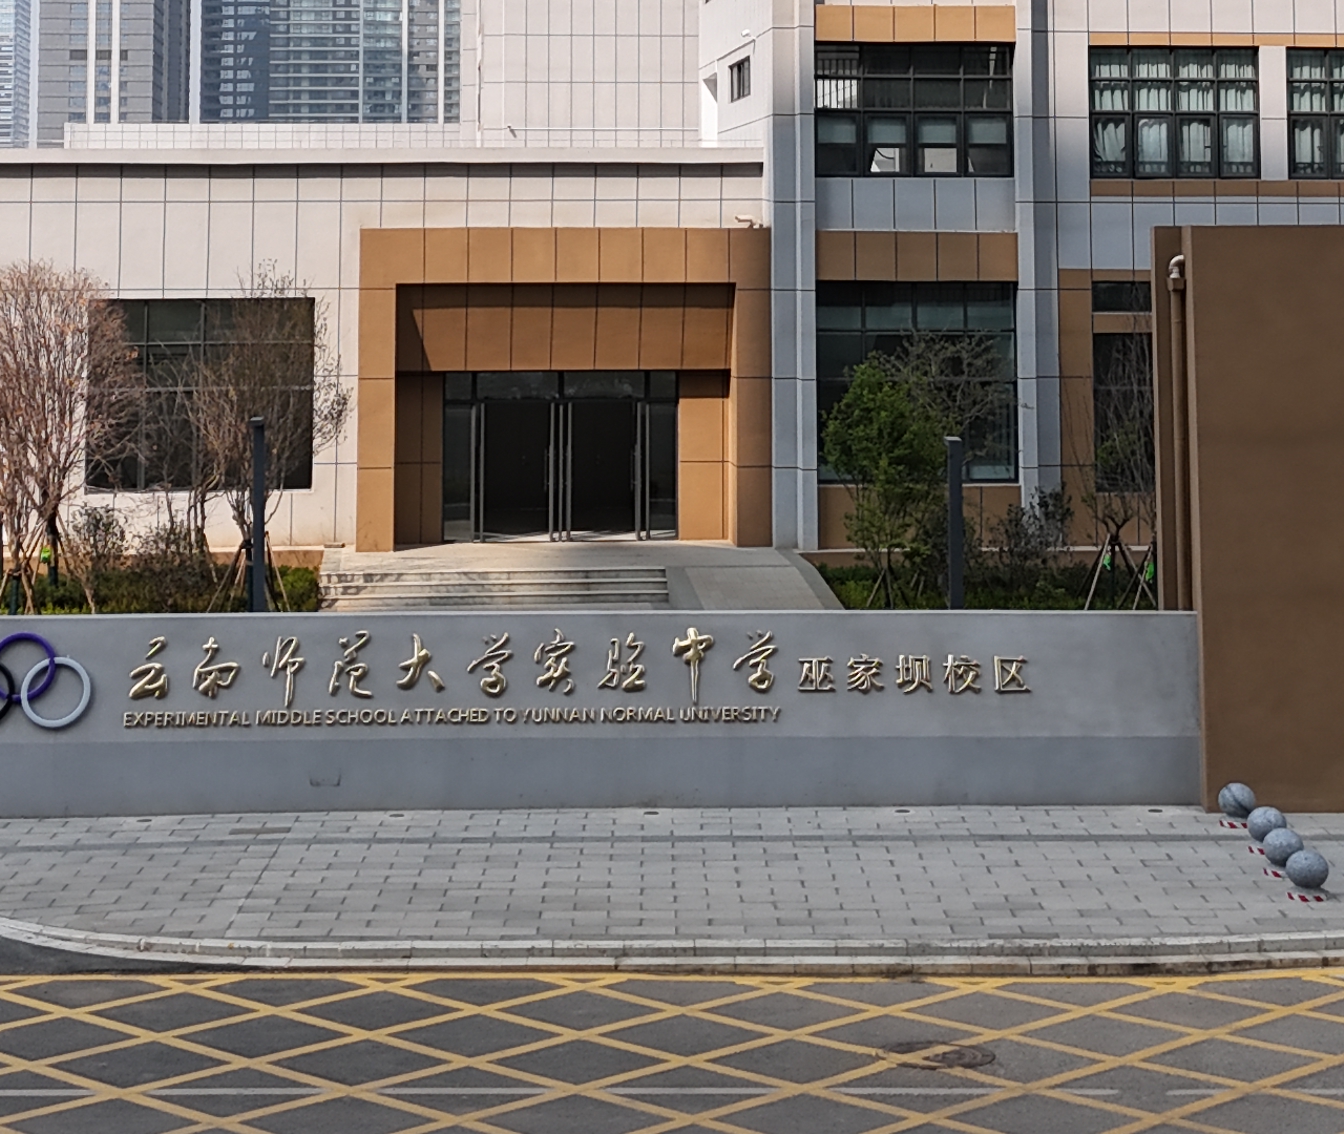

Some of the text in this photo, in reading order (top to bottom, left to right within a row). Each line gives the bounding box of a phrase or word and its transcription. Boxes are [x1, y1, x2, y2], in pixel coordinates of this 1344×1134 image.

[128, 628, 1032, 708] 云南师范大学实验中学 巫家坝校区
[123, 706, 781, 728] EXPERIMENTAL MIDDLE SCHOOL ATTACHED TO YUNNAN NORMAL UNIVERSITY
